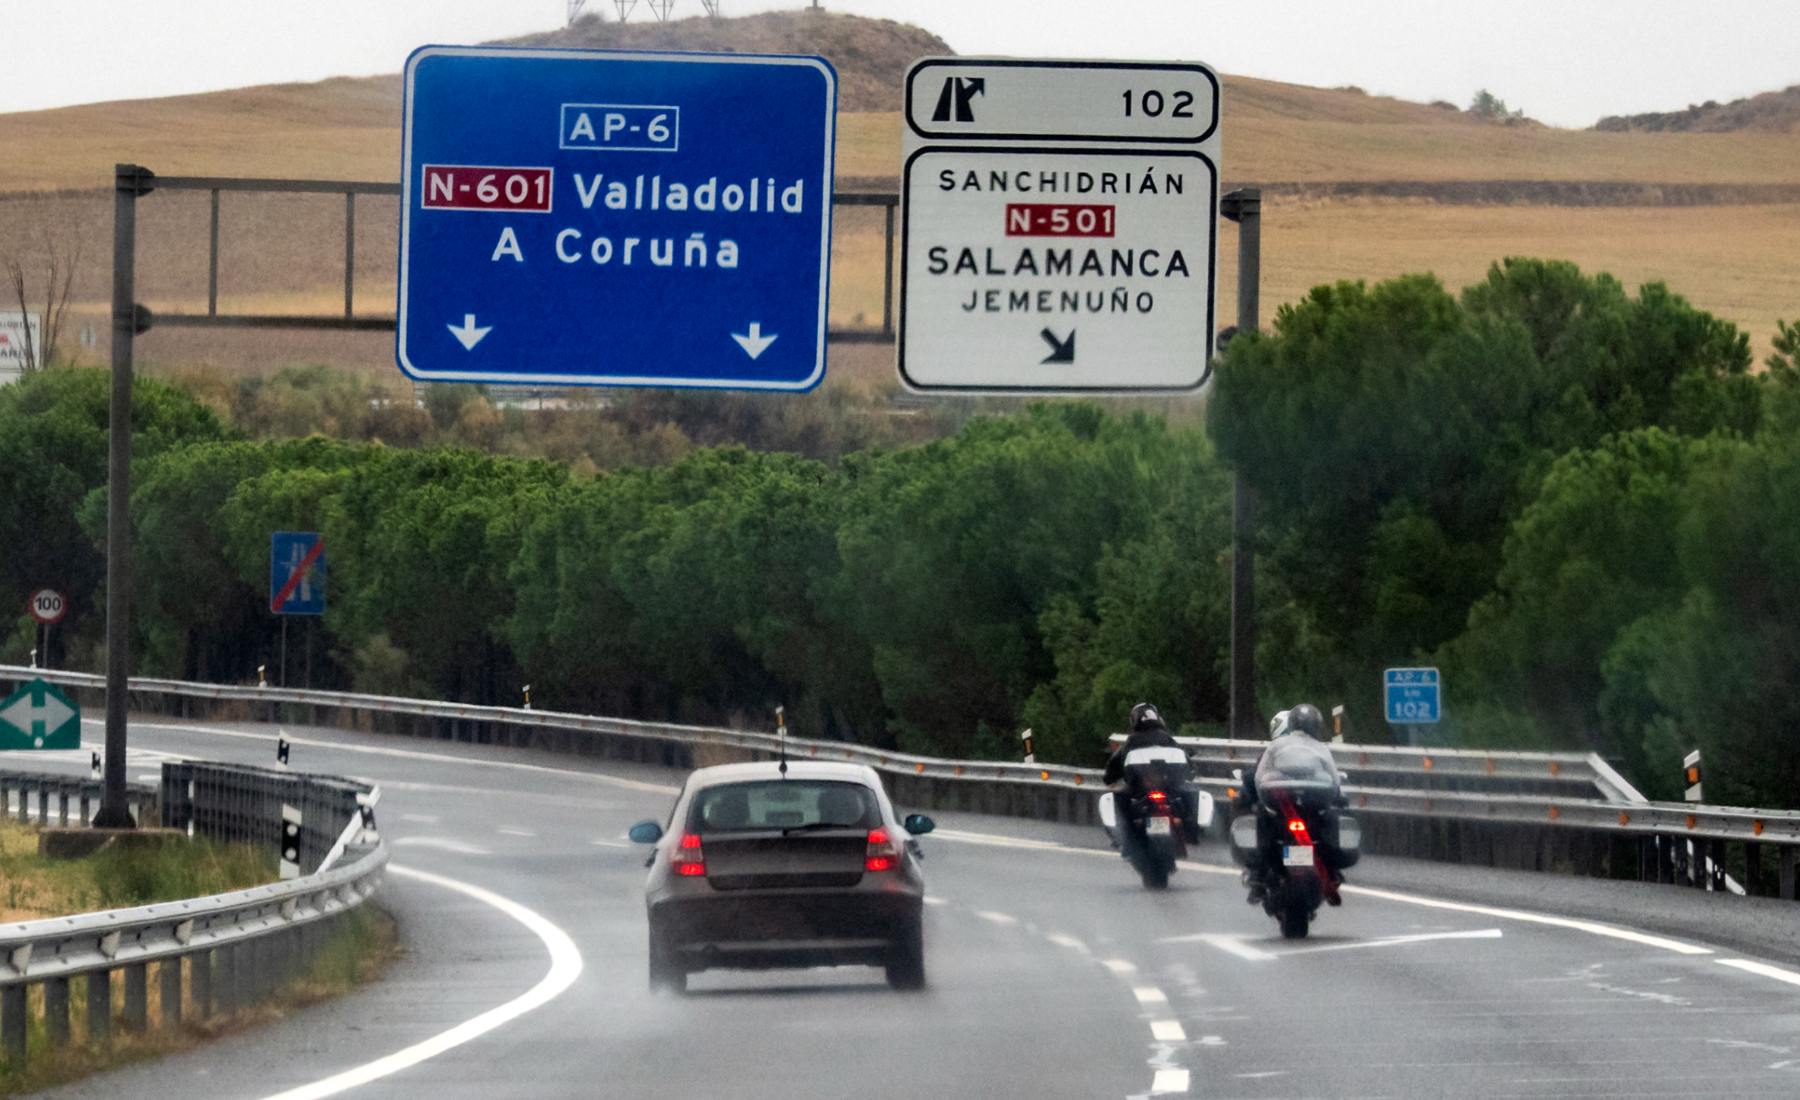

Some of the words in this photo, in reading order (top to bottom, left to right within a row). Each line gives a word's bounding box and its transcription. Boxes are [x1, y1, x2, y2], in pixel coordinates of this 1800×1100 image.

[1122, 90, 1194, 118] 102
[569, 113, 670, 142] AP-6
[430, 173, 545, 205] N-601
[573, 173, 804, 213] Valladolid
[939, 167, 1184, 195] SANCHIDRIÁN
[1010, 208, 1112, 233] N-501
[492, 227, 524, 262] A
[555, 228, 740, 268] Coruña
[928, 247, 1190, 278] SALAMANCA
[961, 287, 1154, 314] JEMENUÑO
[36, 597, 62, 611] 100
[1395, 702, 1431, 718] 102
